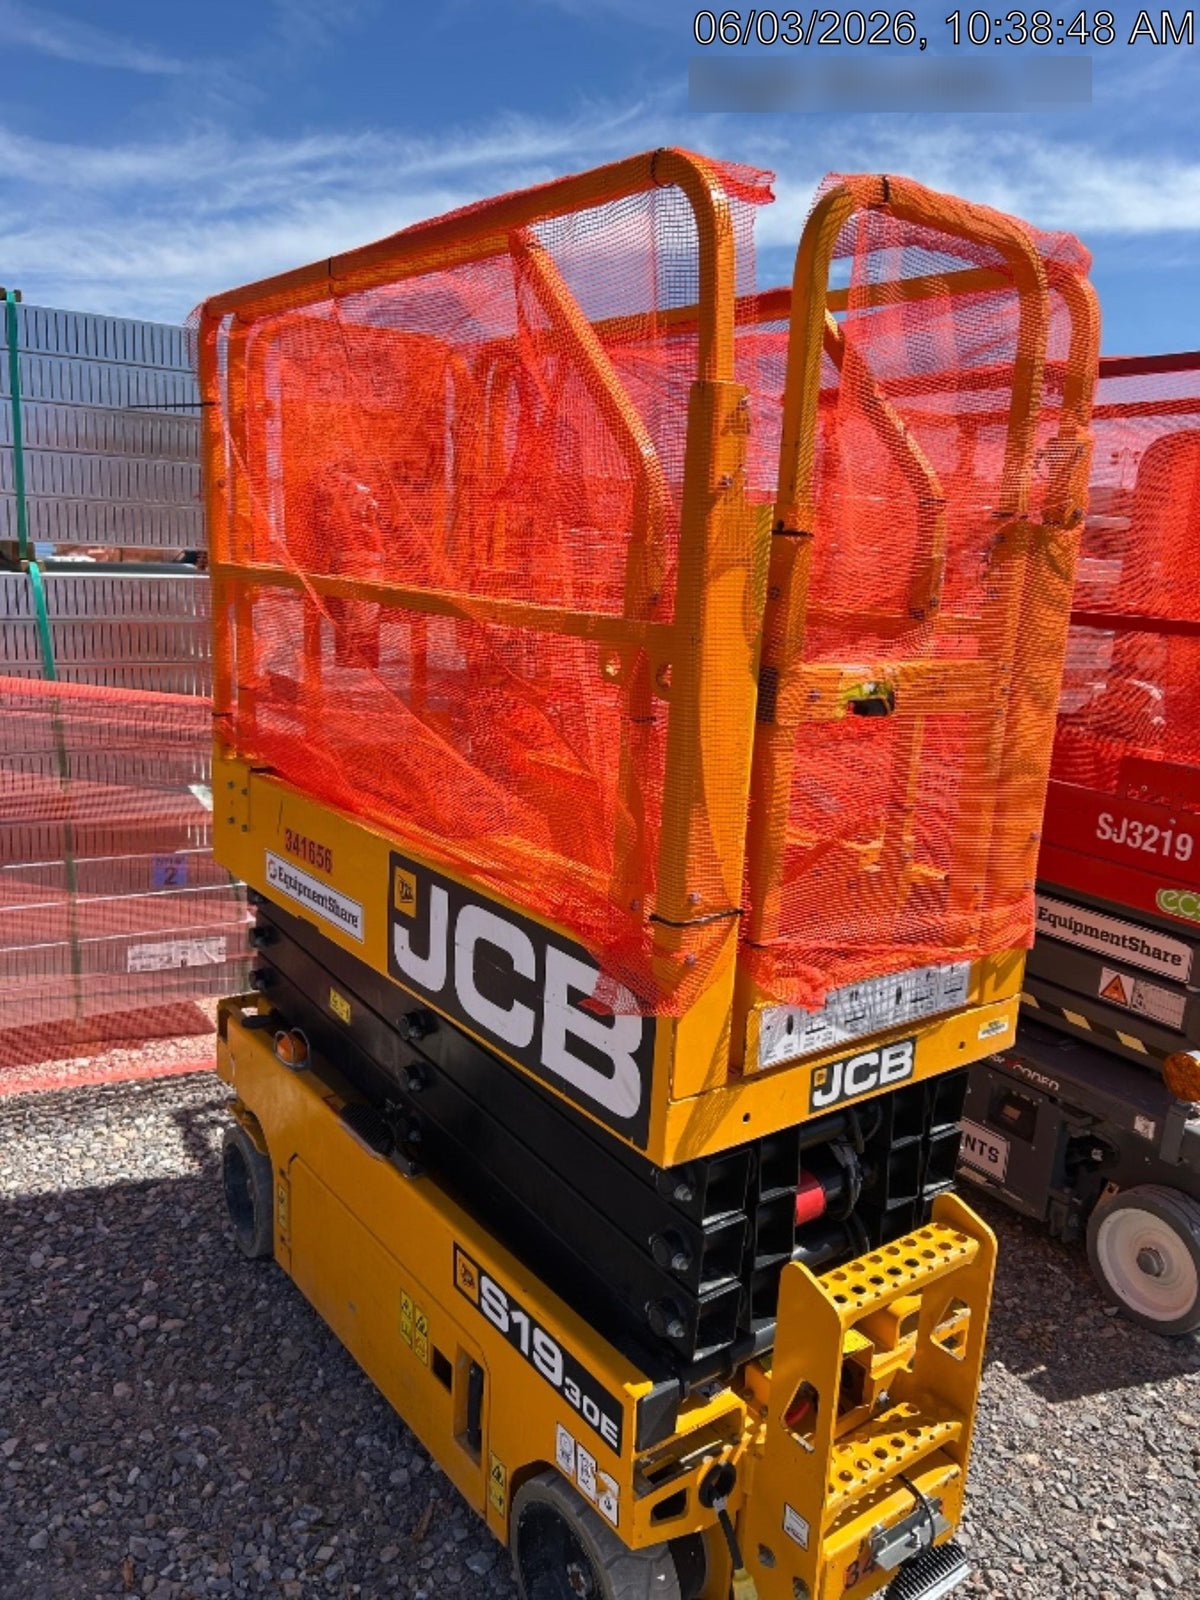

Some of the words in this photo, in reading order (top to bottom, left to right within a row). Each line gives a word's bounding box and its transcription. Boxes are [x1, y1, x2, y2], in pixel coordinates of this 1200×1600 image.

[285, 828, 333, 874] 341656
[1096, 812, 1194, 862] SJ3219
[278, 866, 359, 929] EquipmentShare
[1160, 890, 1200, 918] ec
[1037, 906, 1183, 966] EquipmentShare
[393, 884, 643, 1119] JCB
[812, 1041, 913, 1107] JCB
[965, 1134, 1000, 1163] NTS
